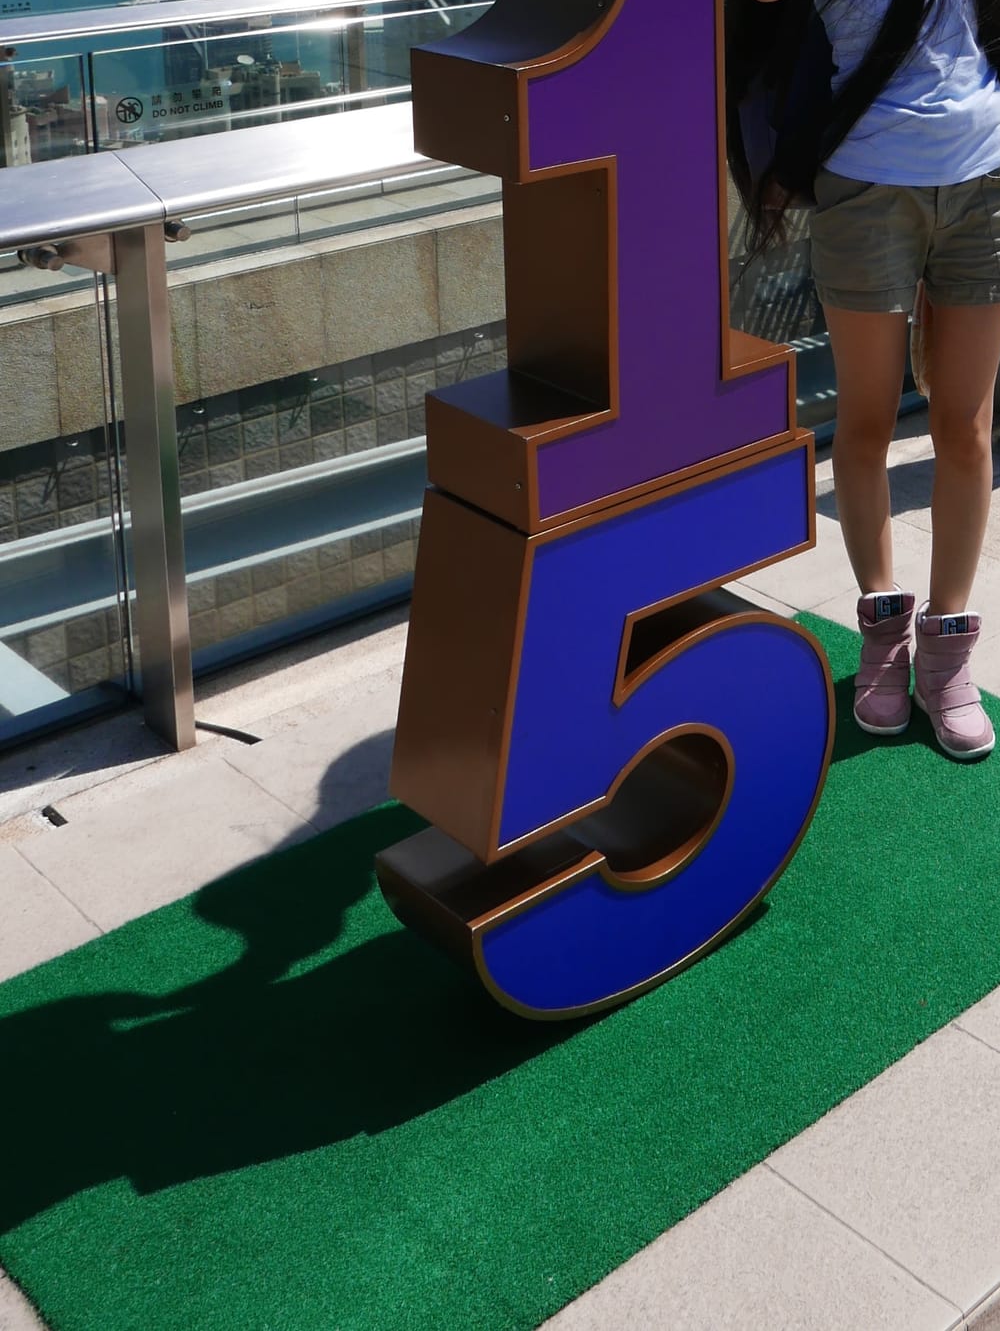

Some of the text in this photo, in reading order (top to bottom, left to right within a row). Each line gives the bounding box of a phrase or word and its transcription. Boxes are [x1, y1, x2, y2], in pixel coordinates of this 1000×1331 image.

[152, 100, 223, 118] DO NOT CLIMB
